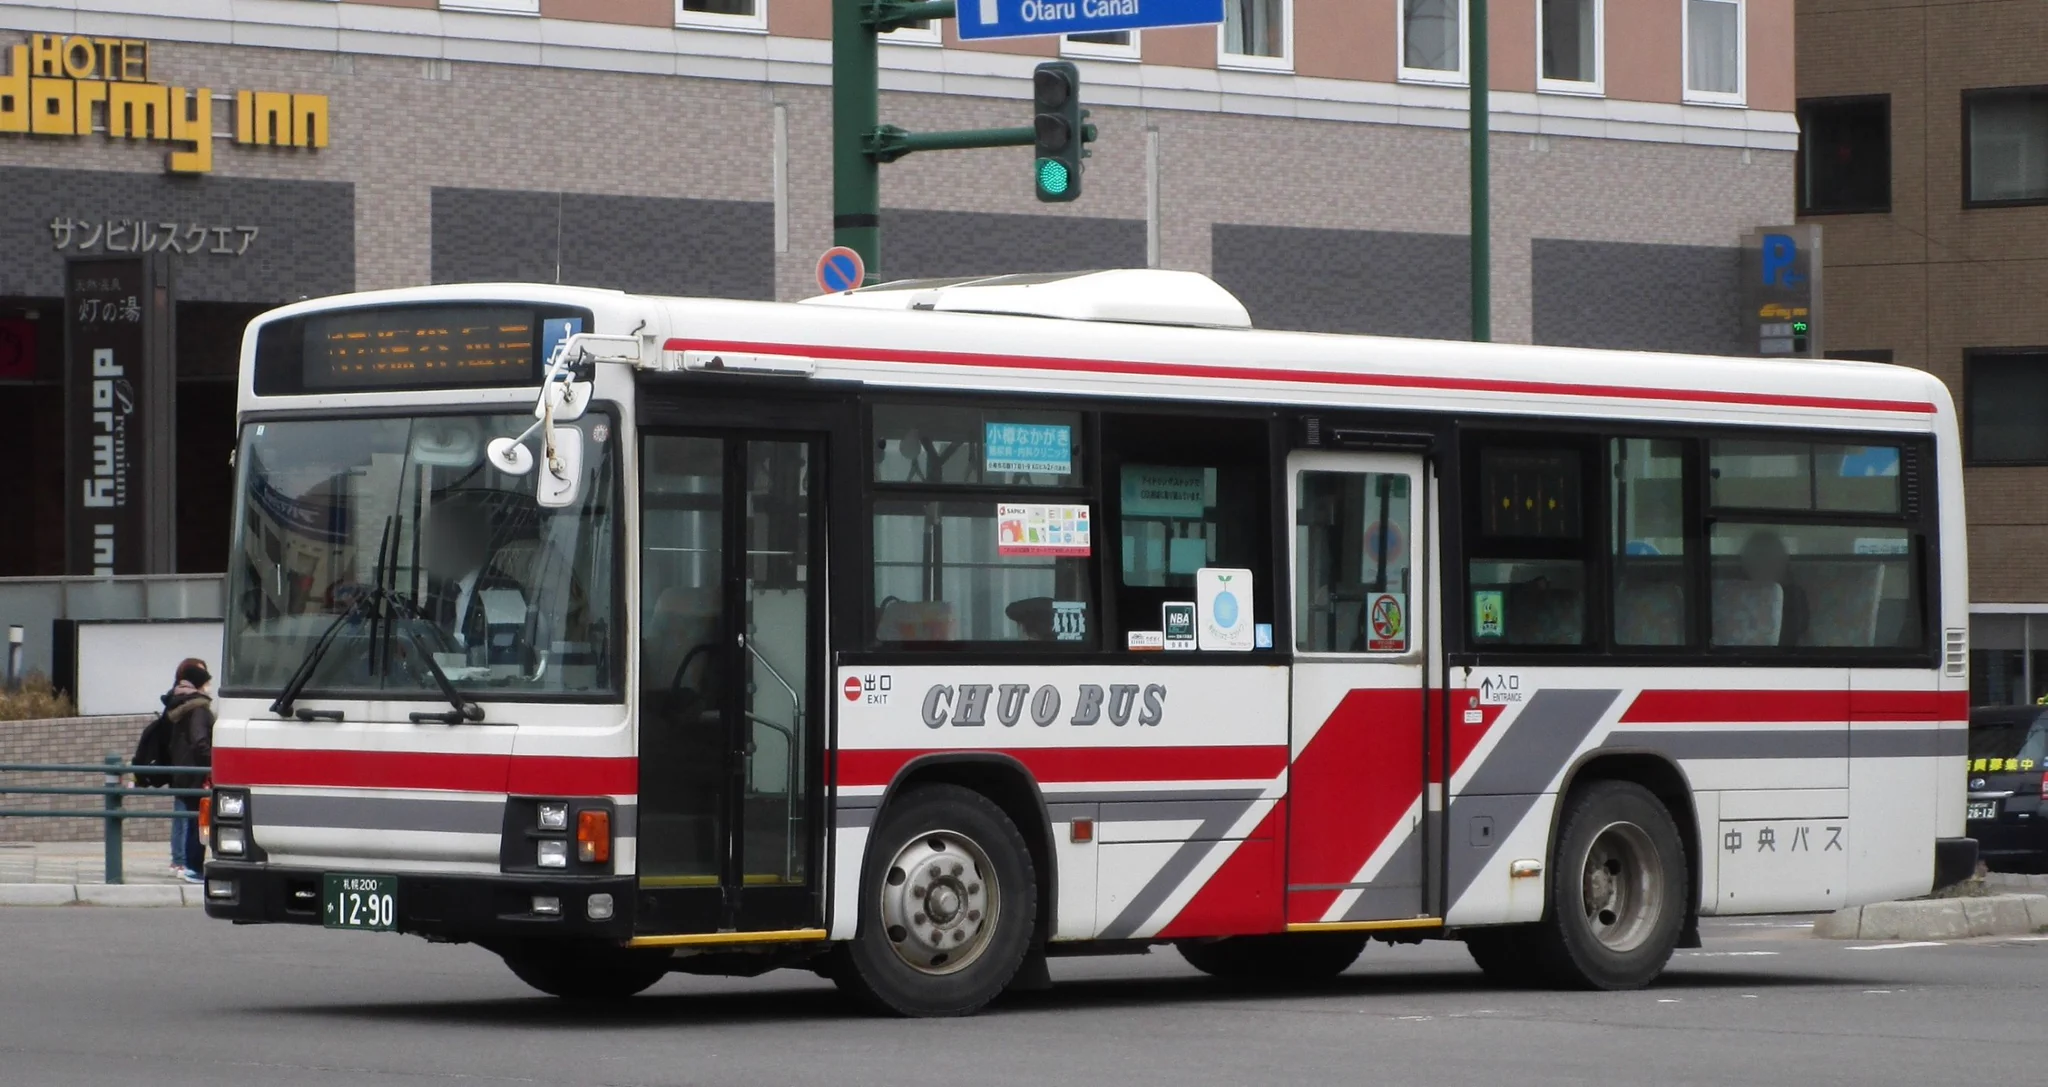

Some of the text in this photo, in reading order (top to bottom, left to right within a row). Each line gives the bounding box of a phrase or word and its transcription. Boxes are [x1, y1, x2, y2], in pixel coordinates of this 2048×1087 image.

[1021, 0, 1139, 22] Otaru Canal
[0, 44, 212, 172] dormy
[50, 217, 260, 256] サンビルスクエア
[1763, 234, 1796, 285] P
[79, 295, 141, 323] 灯の湯
[84, 348, 124, 507] dormy
[1169, 612, 1190, 624] NBA
[864, 674, 892, 691] 出口
[1496, 673, 1519, 690] 入口
[867, 694, 888, 704] EXIT
[921, 683, 1168, 730] CHUO BUS
[1493, 692, 1522, 702] ENTRANCE
[1724, 826, 1843, 854] 中央バス
